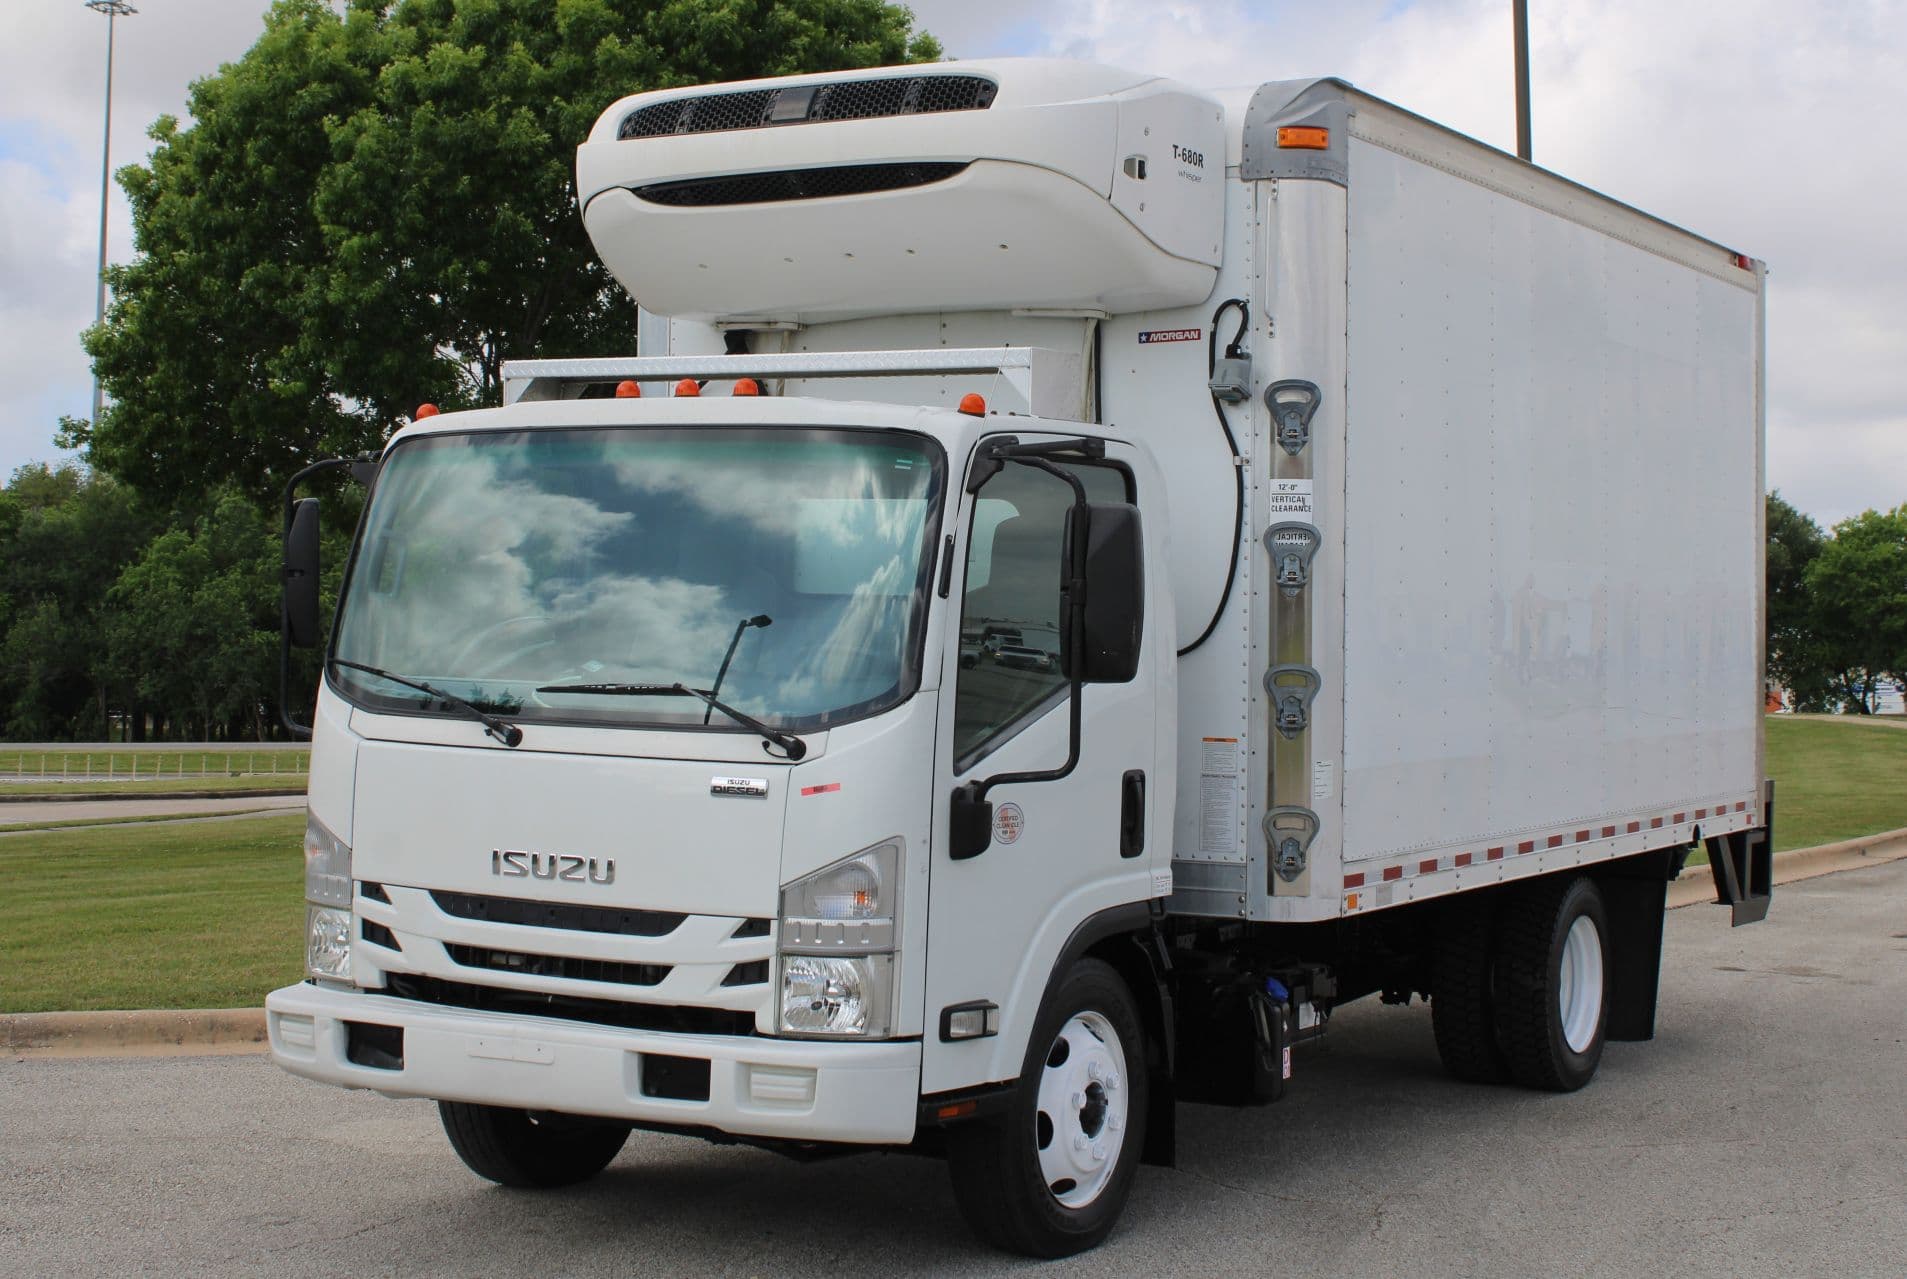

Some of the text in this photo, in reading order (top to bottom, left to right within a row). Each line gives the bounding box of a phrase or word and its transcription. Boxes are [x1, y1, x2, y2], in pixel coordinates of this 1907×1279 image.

[1172, 144, 1204, 168] T-680R
[1150, 331, 1199, 341] MORGAN
[711, 785, 766, 796] DIESEL
[492, 849, 616, 885] ISUZU
